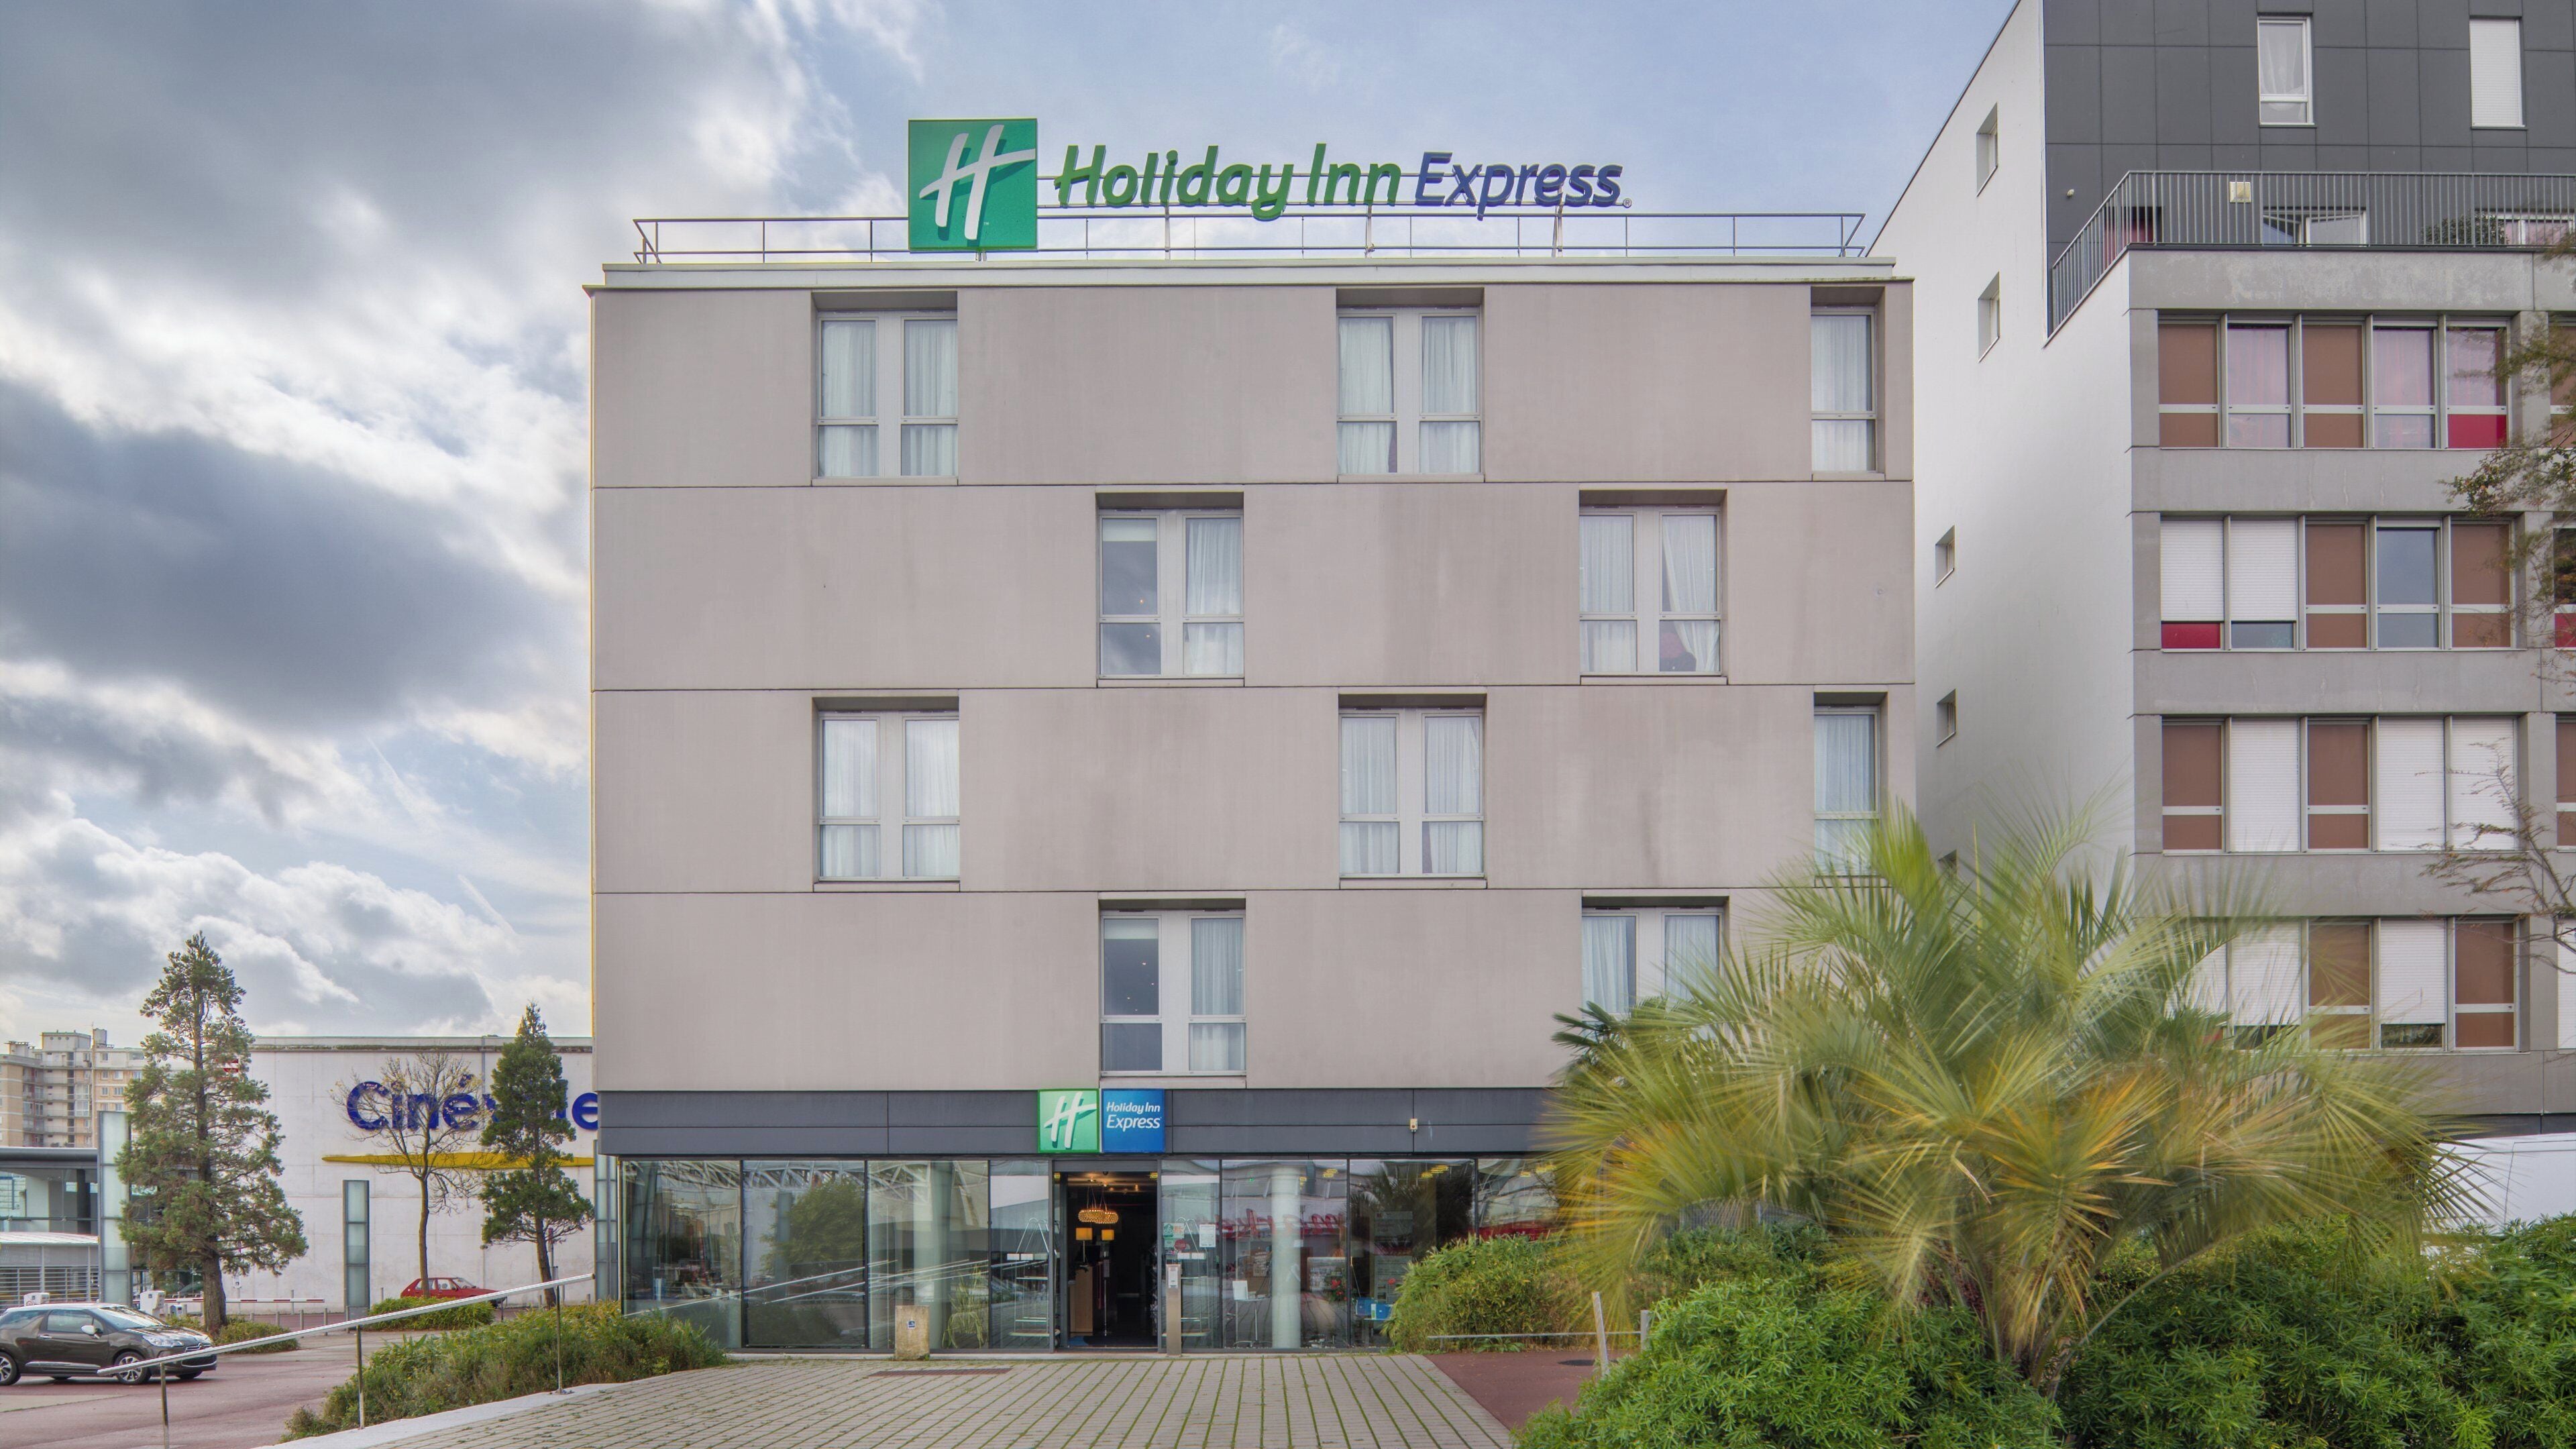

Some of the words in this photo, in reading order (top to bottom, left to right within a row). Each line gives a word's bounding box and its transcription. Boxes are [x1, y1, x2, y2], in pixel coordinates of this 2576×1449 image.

[1054, 144, 1294, 221] Holiday
[1307, 143, 1401, 207] Inn
[1415, 152, 1623, 221] Express
[1106, 1102, 1144, 1114] Holiday
[1145, 1102, 1161, 1112] Inn
[1106, 1114, 1161, 1132] Express
